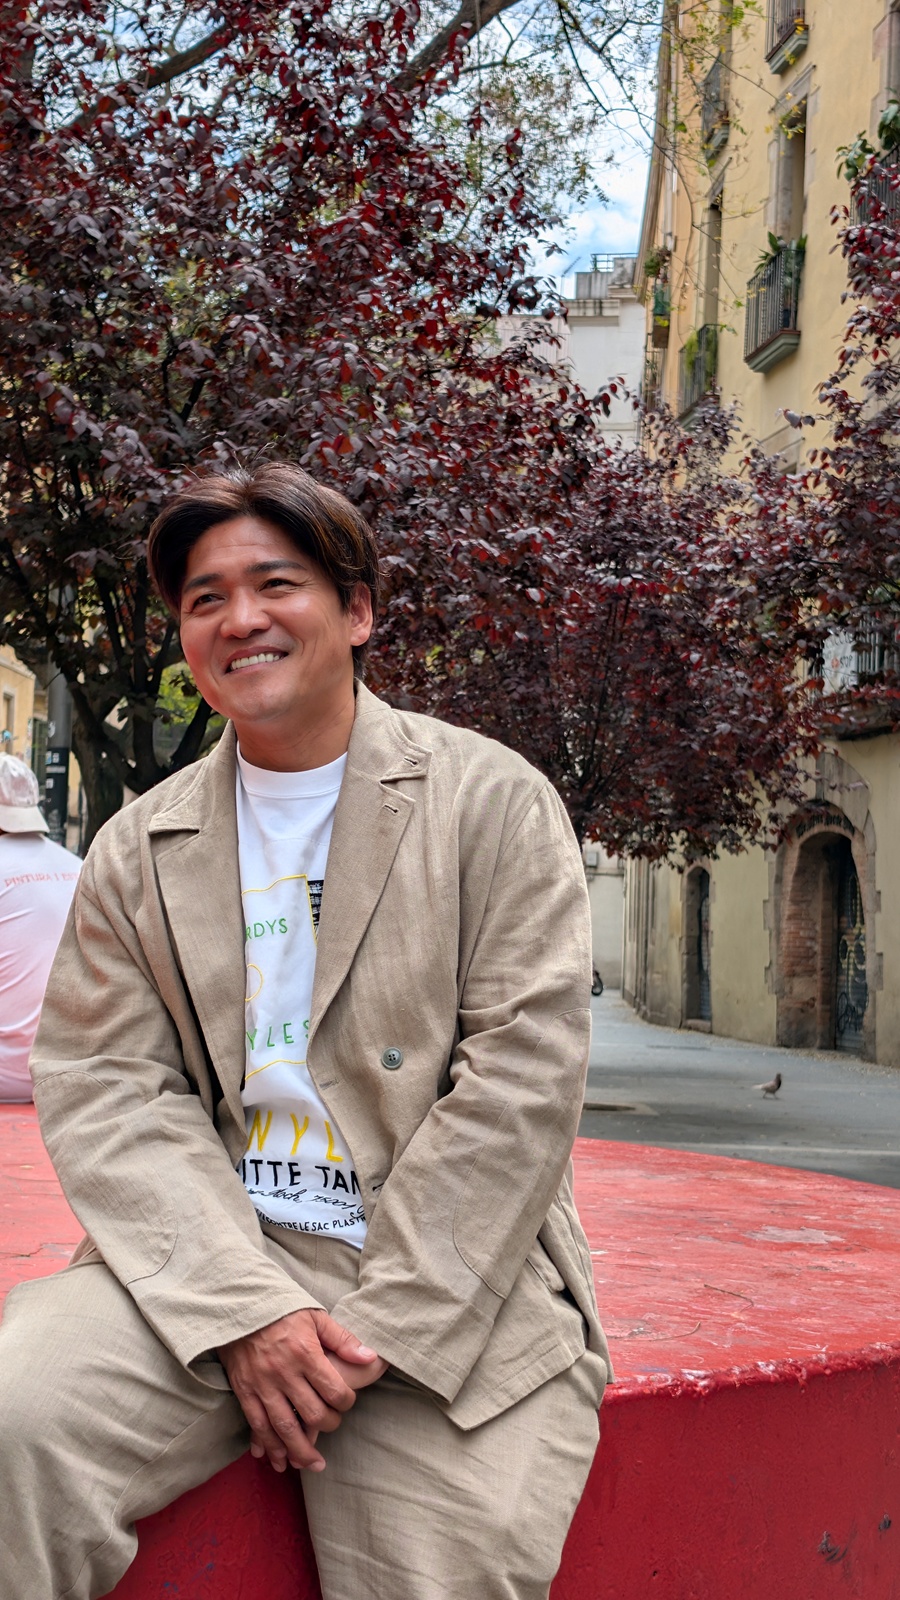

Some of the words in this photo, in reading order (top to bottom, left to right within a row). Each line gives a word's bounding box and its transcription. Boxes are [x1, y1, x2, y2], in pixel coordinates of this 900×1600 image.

[235, 1158, 301, 1187] ITTE
[299, 1221, 310, 1232] LE
[311, 1221, 330, 1232] SAC
